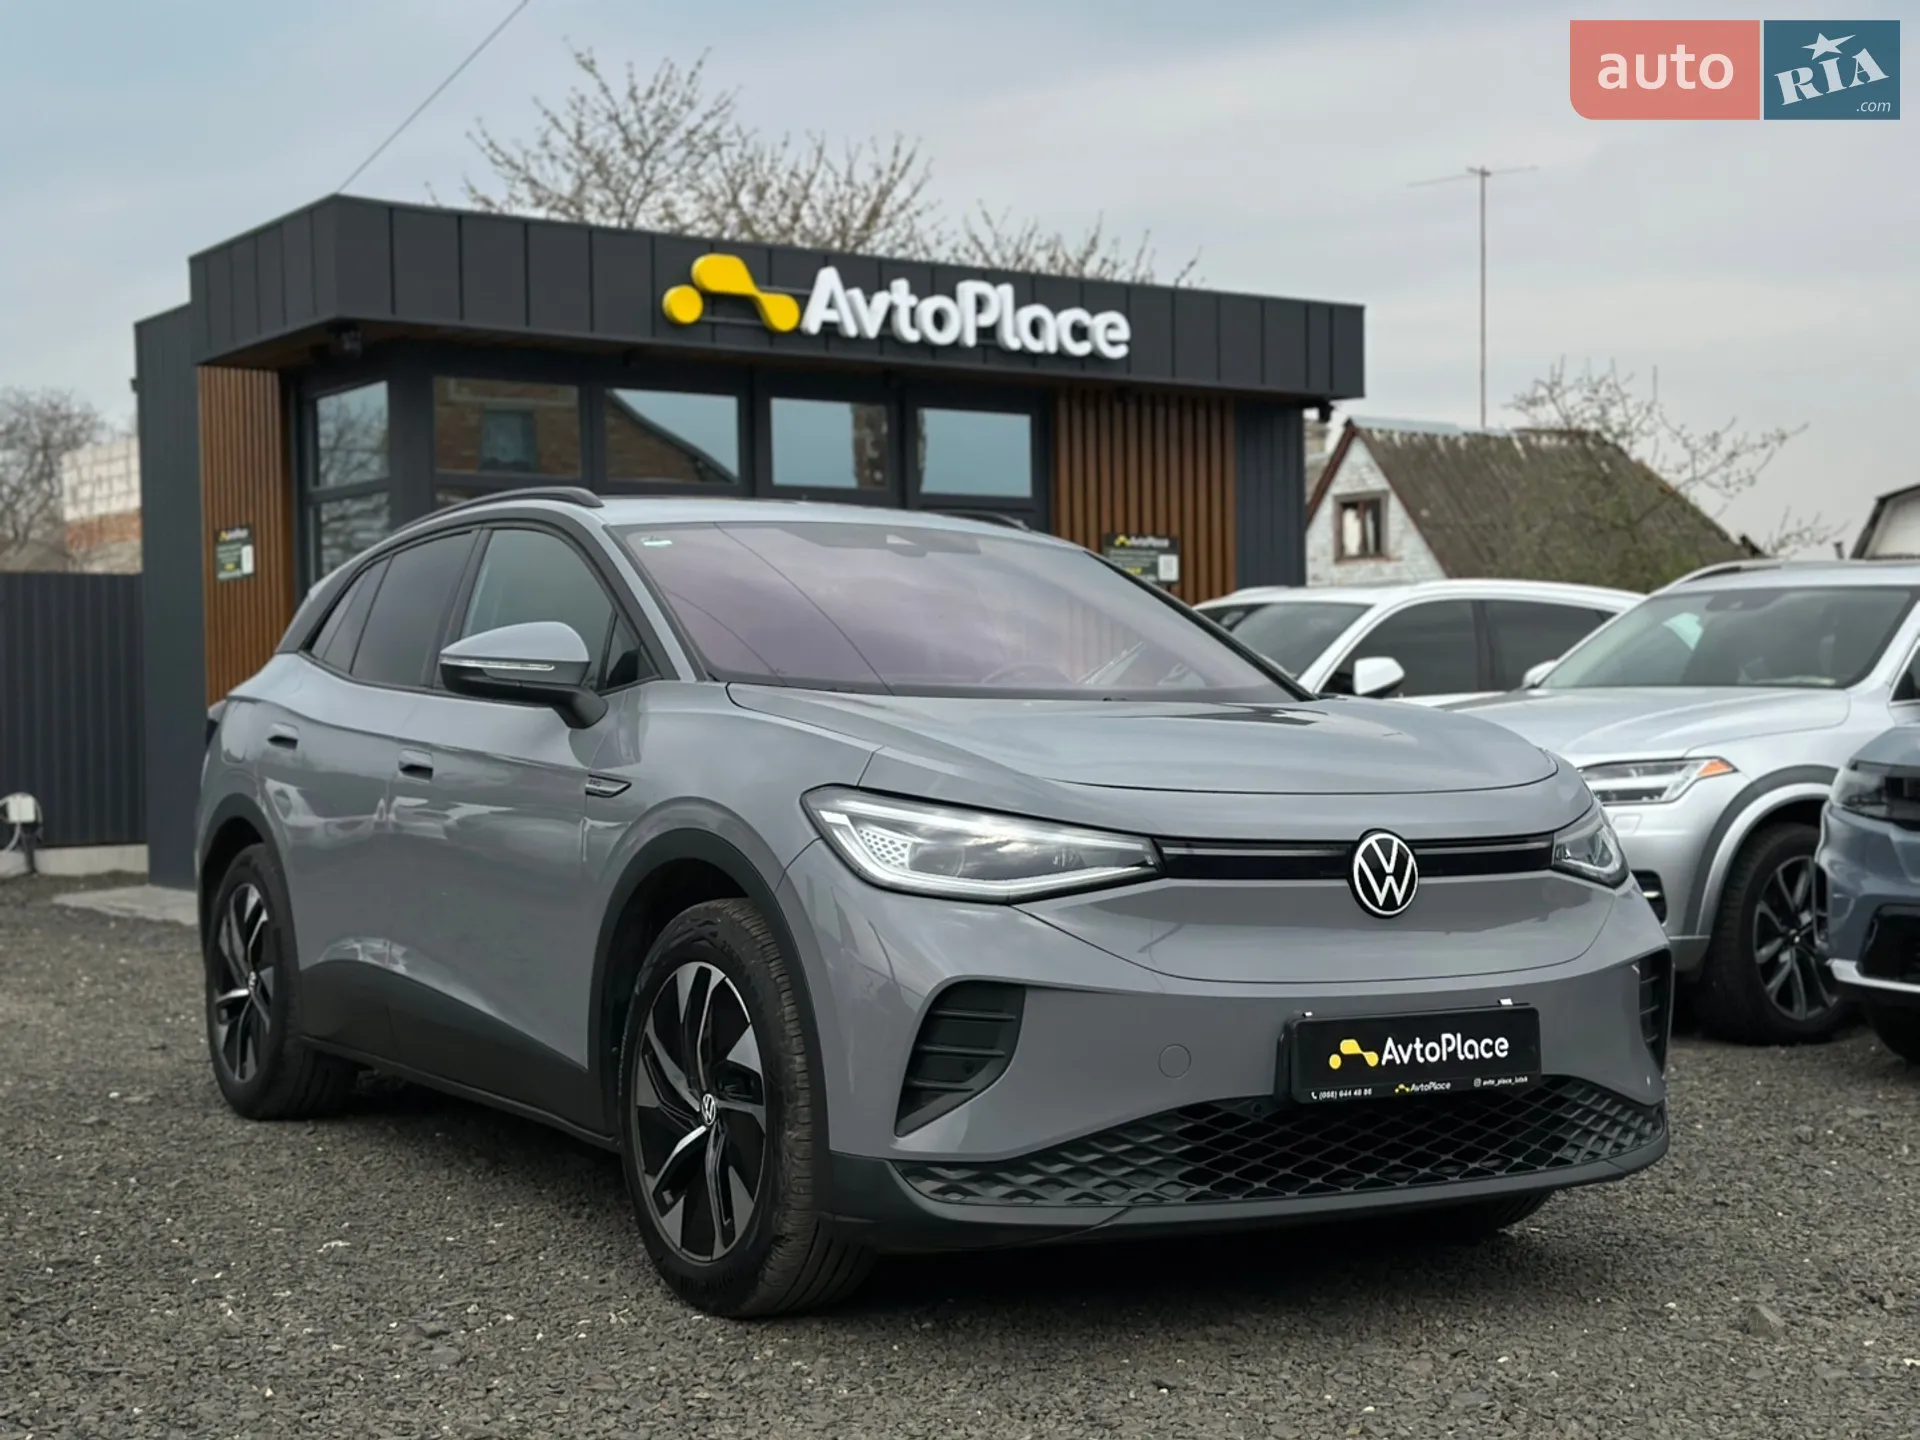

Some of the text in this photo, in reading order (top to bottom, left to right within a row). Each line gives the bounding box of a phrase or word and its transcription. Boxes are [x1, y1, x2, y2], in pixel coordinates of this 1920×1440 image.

[801, 266, 1130, 359] AvtoPlace
[1381, 1032, 1509, 1066] AvtoPlace
[1411, 1081, 1451, 1092] AvtoPlace
